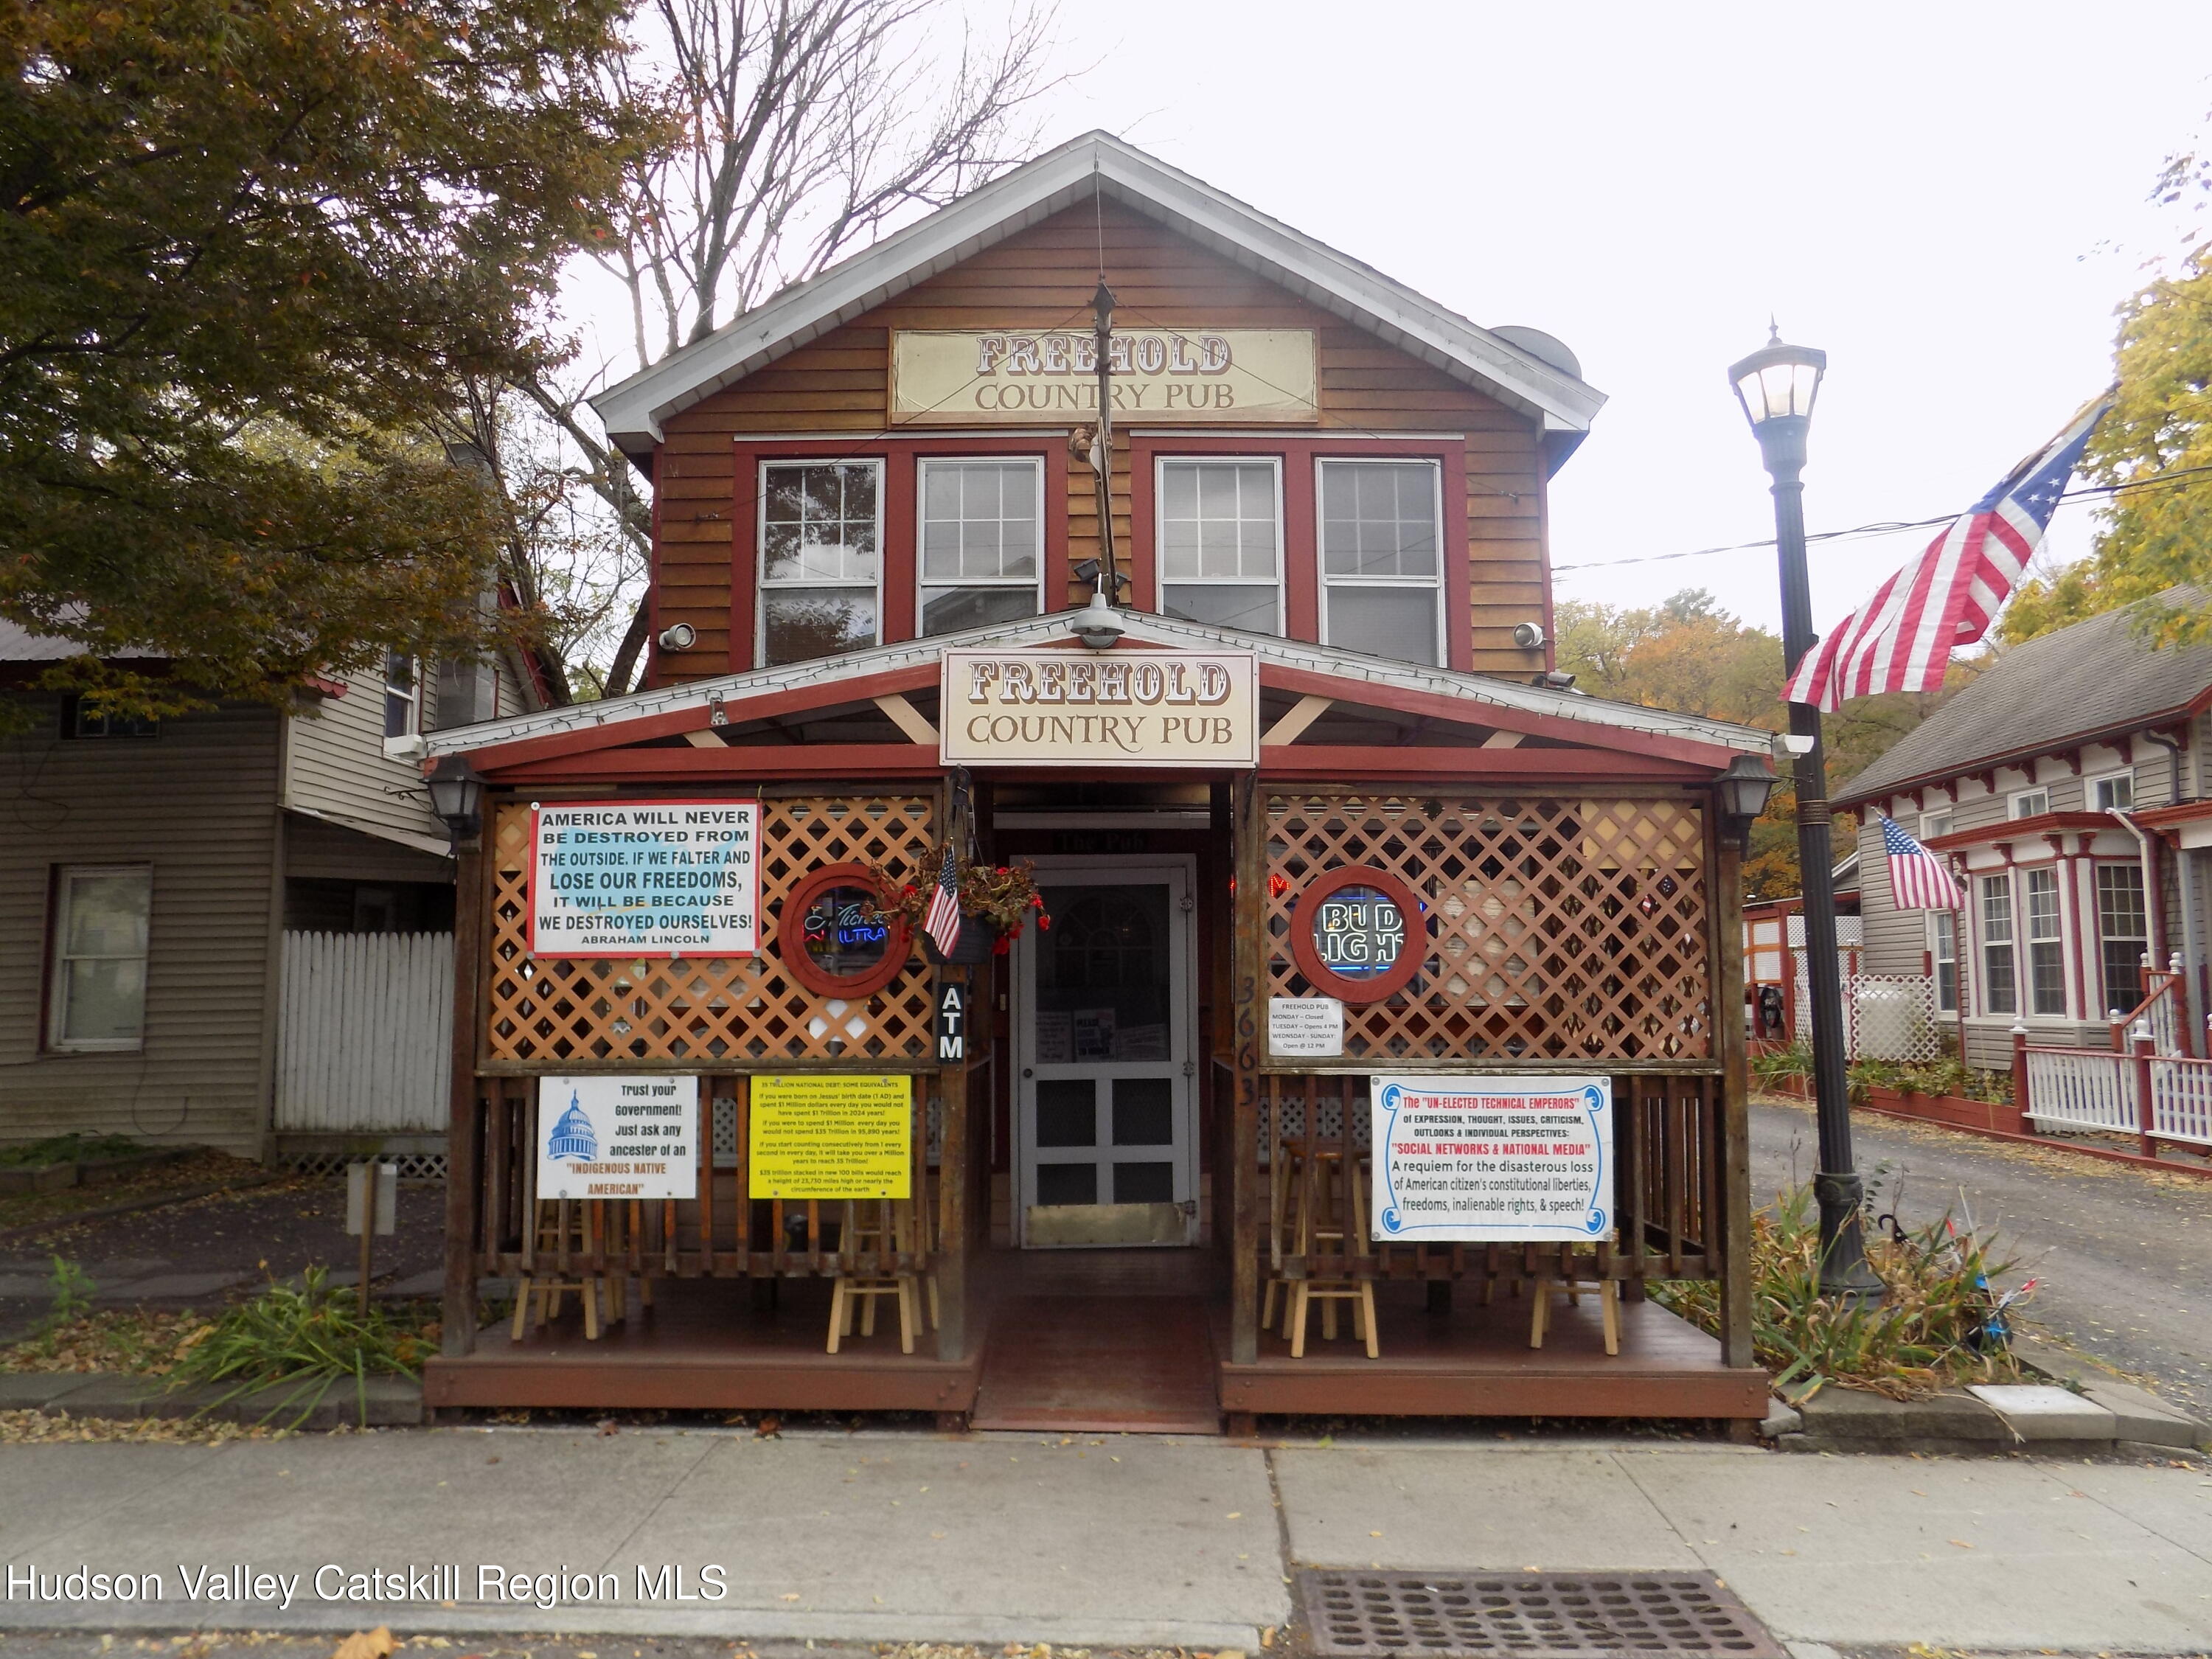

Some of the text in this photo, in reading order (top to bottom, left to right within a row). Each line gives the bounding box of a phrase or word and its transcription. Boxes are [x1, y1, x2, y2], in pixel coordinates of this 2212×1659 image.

[975, 335, 1234, 376] FREEHOLD
[975, 383, 1234, 410] COUNTRY PUB
[967, 661, 1231, 706] FREEHOLD
[967, 713, 1232, 753] COUNTRY PUB
[542, 811, 749, 826] AMERICA WILL NEVER
[543, 831, 748, 844] BE DESTROYED FROM
[541, 851, 750, 866] THE OUTSIDE. IF WE FALTER AND
[551, 872, 741, 891] LOSE OUR FREEDOMS,
[554, 895, 733, 908] IT WILL BE BECAUSE
[539, 914, 751, 930] WE DESTROYED OURSELVES!
[1322, 903, 1402, 932] BUD
[582, 935, 709, 944] ABRAHAM LINCOLN
[939, 987, 963, 1059] ATM
[622, 1084, 676, 1096] Trust your
[1403, 1096, 1579, 1109] The "UN-ELECTED TECHNICAL EMPERORS"
[615, 1105, 681, 1116] Government!
[1403, 1115, 1584, 1124] of EXPRESSION, THOUGHT, ISSUES, CRITICISM,
[615, 1124, 681, 1137] Just ask any
[1414, 1128, 1454, 1137] OUTLOOKS
[610, 1144, 686, 1156] ancester of an
[1392, 1143, 1590, 1155] "SOCIAL NETWORKS & NATIONAL MEDIA"
[567, 1163, 666, 1174] "INDIGENOUS NATIVE
[1392, 1161, 1593, 1174] A requiem for the disasterous loss
[588, 1183, 644, 1194] AMERICAN"
[1394, 1177, 1591, 1192] of American citizen's constitutional liberties,
[1402, 1197, 1584, 1215] freedoms, inalienable rights, & speech!
